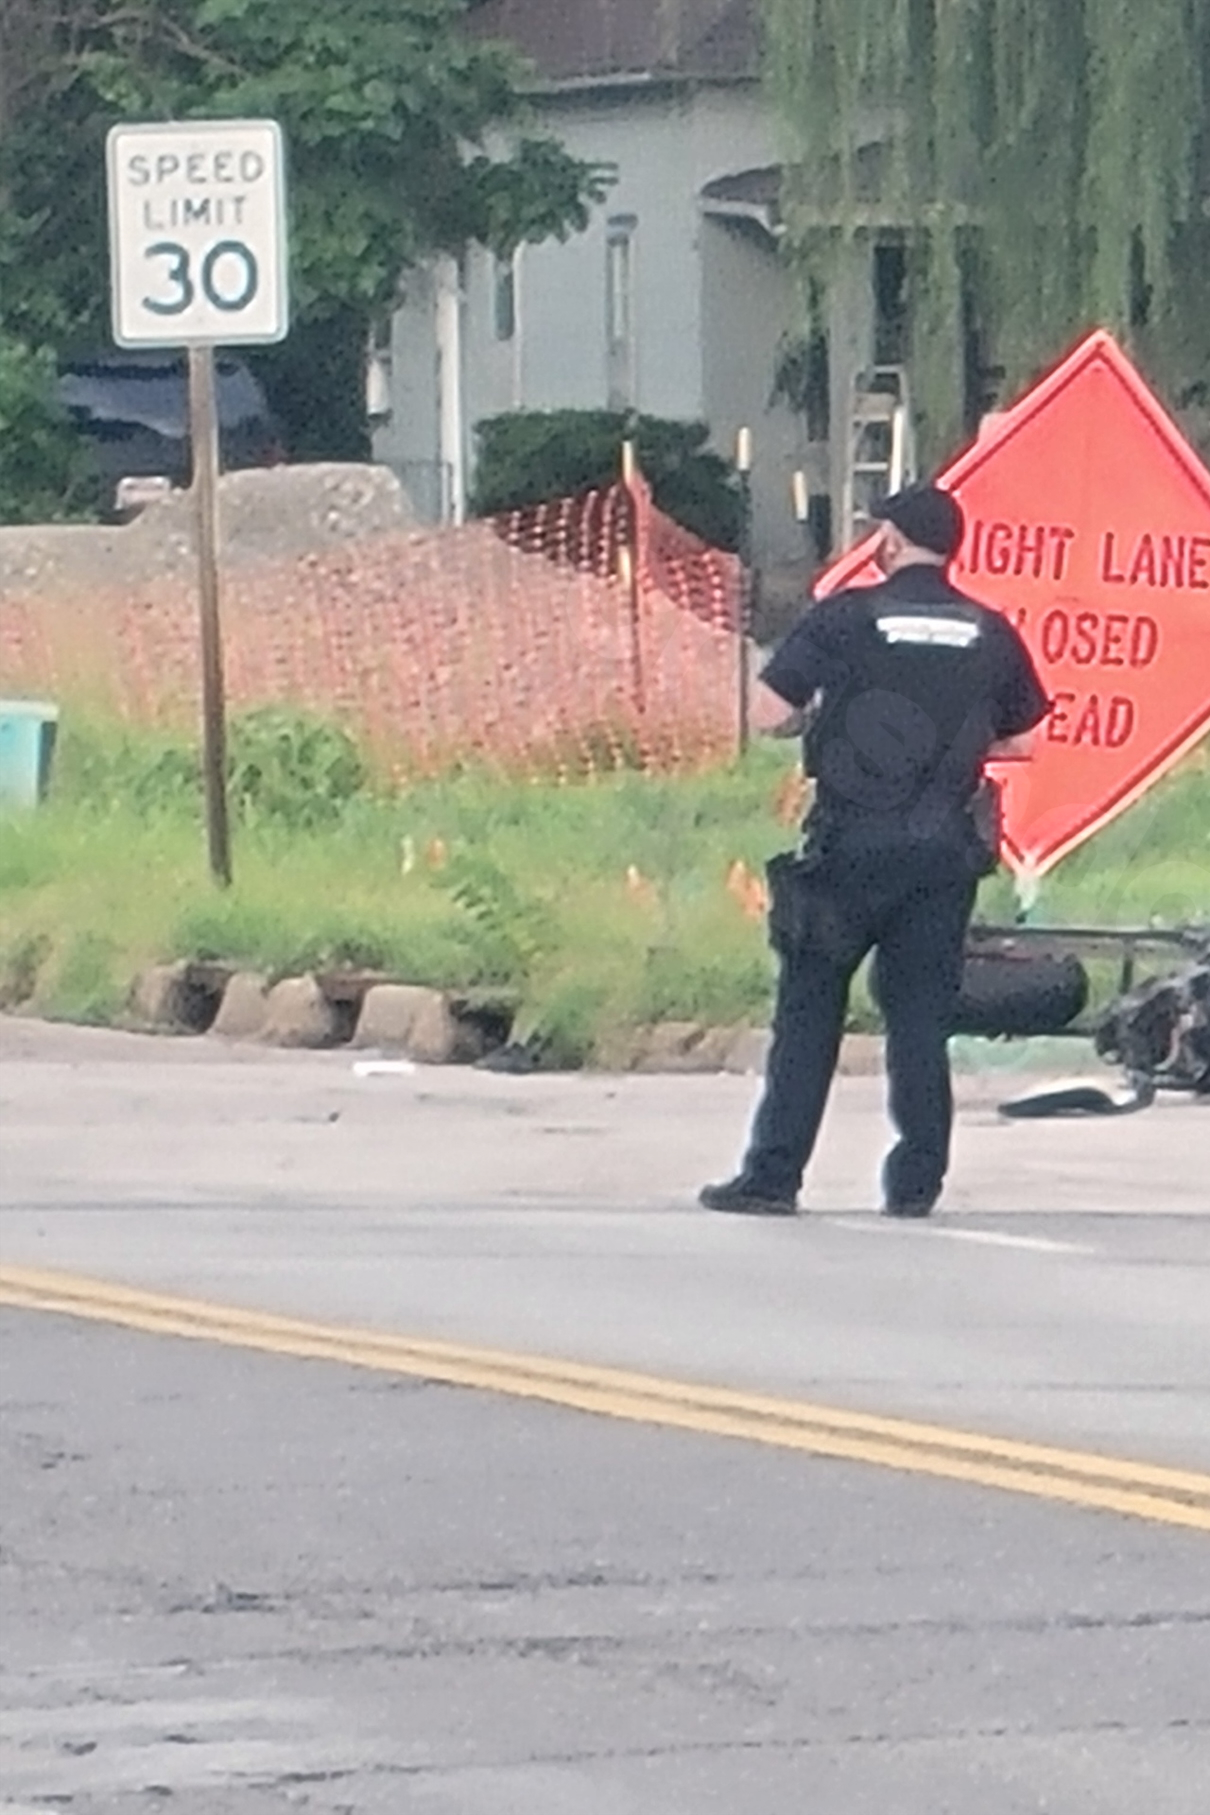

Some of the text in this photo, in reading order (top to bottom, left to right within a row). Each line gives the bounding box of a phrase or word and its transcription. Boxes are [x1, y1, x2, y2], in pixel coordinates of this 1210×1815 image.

[128, 151, 265, 187] SPEED
[143, 196, 247, 230] LIMIT
[142, 240, 259, 315] 30
[958, 519, 1075, 580] IGHT
[1017, 607, 1159, 669] OSED
[1047, 692, 1134, 747] EAD
